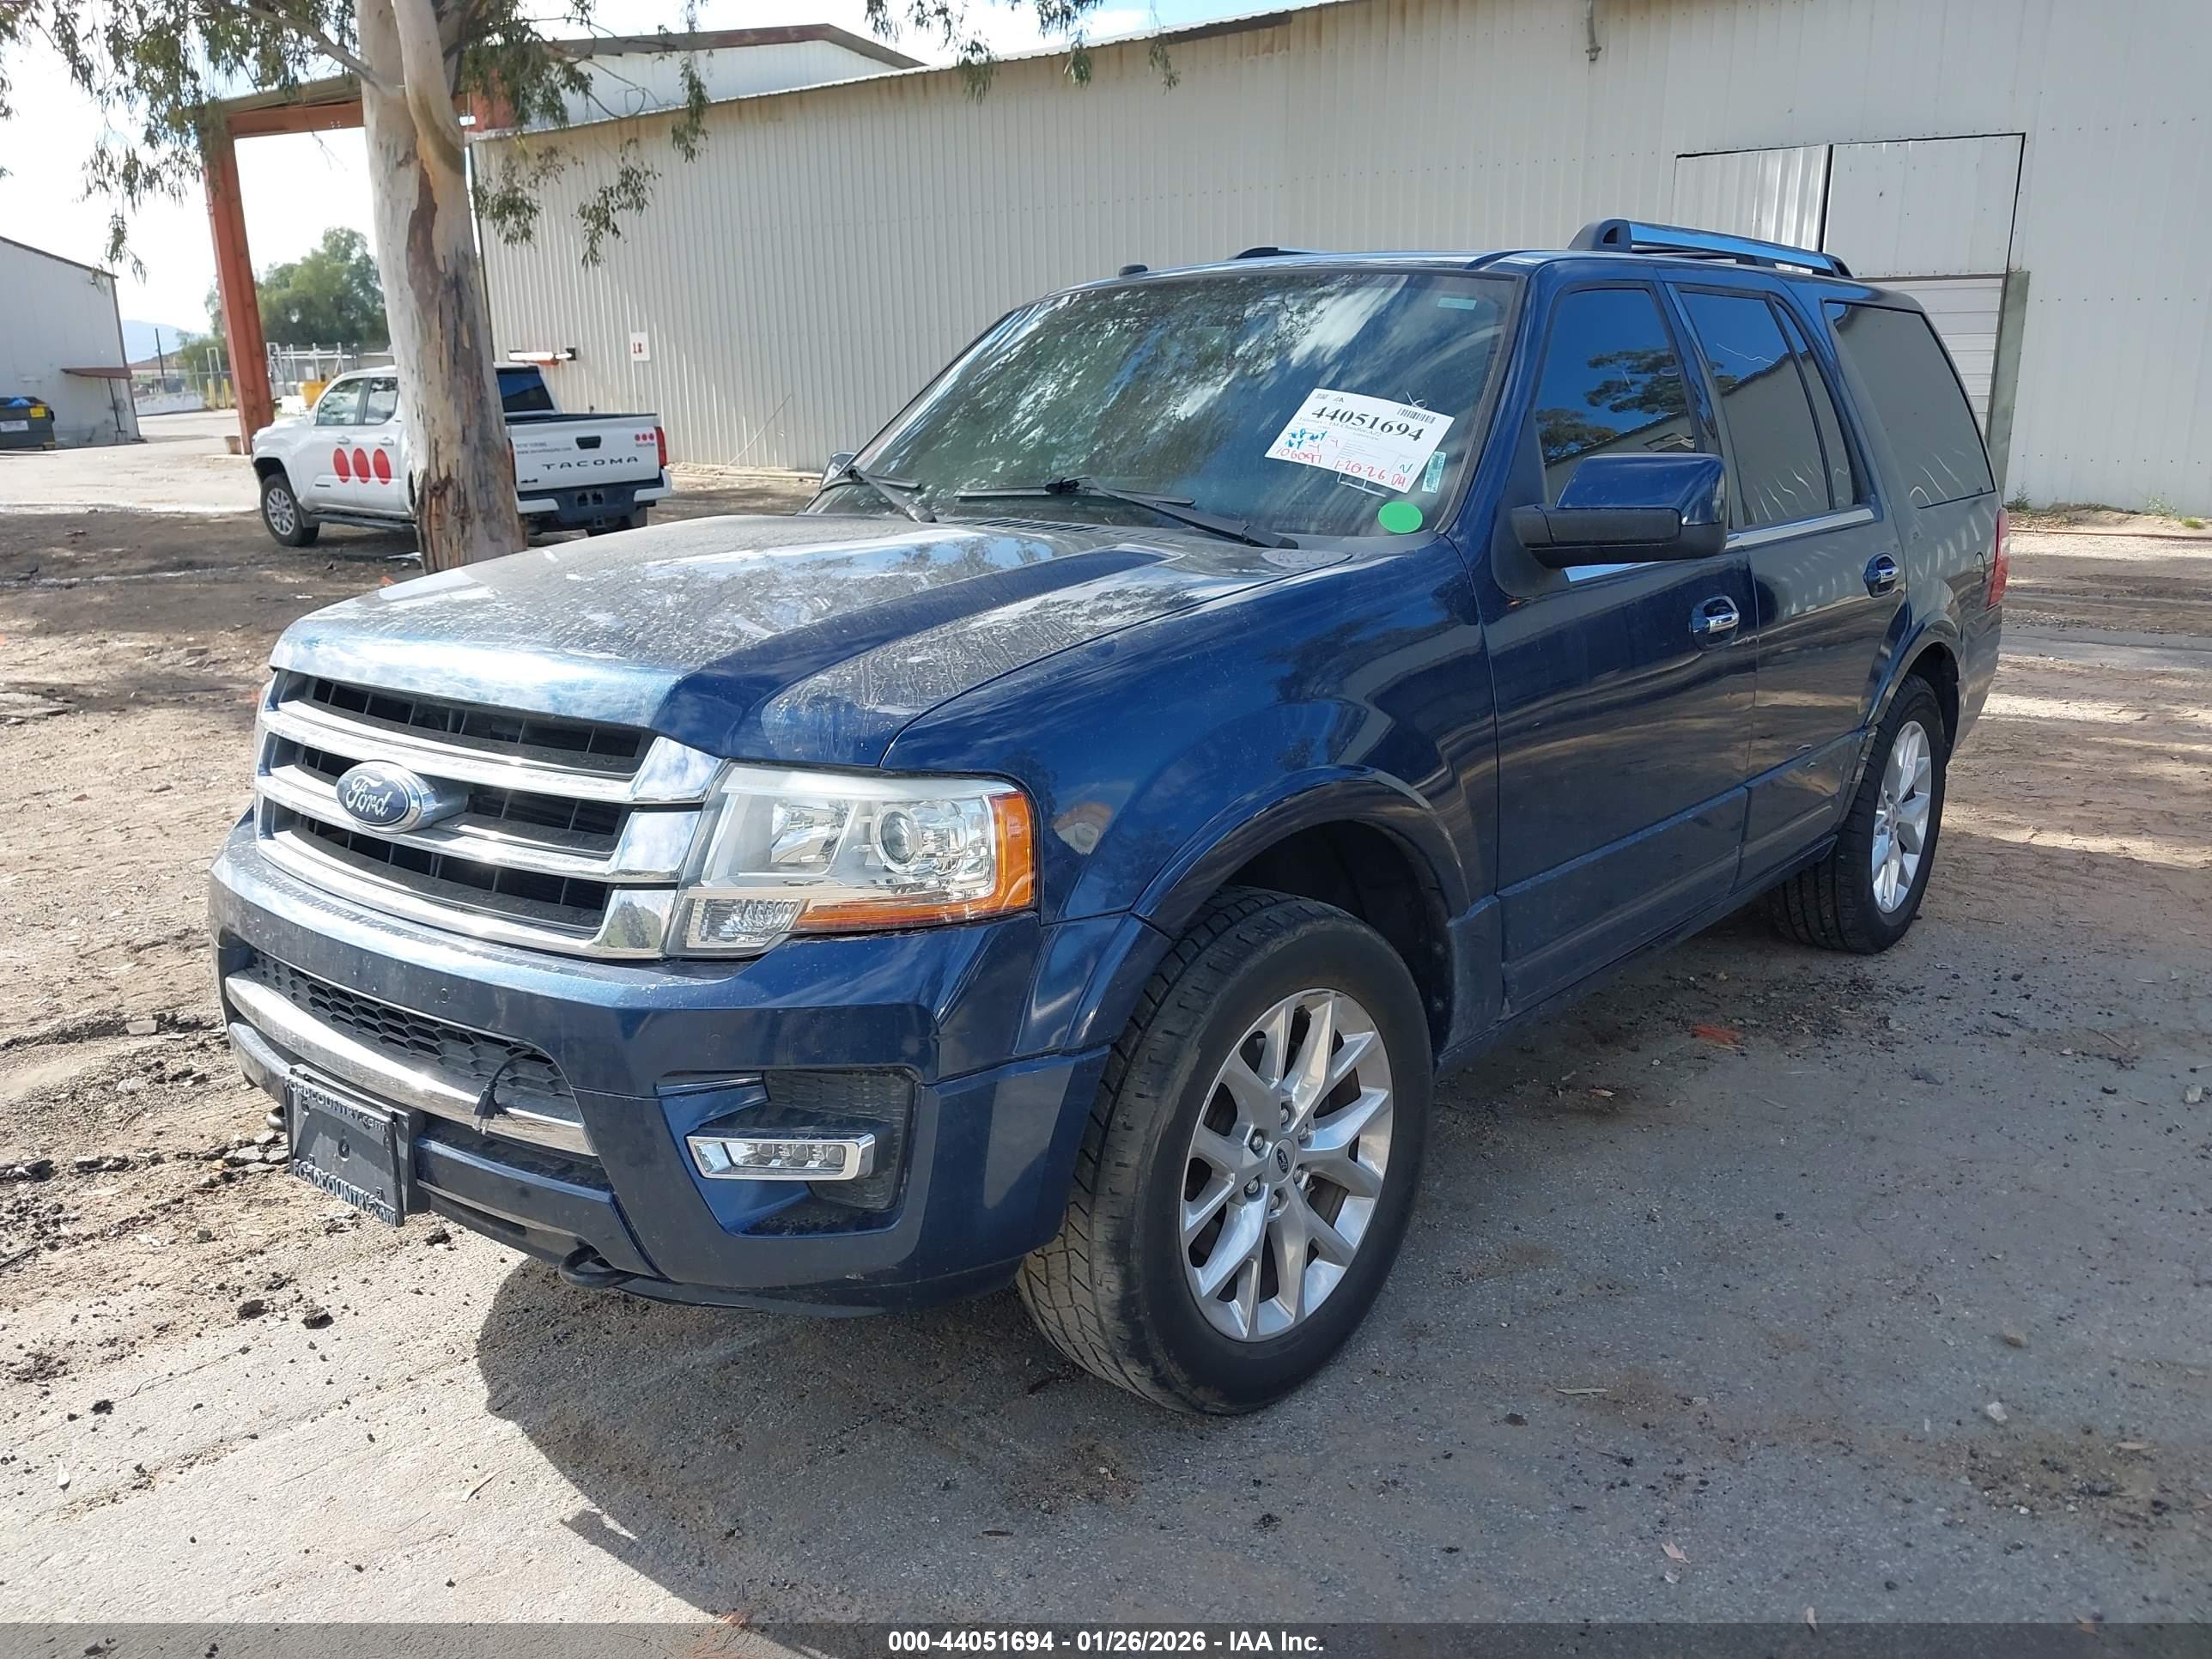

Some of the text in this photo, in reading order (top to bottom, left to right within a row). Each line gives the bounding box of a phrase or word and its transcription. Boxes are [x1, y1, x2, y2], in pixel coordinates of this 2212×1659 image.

[1311, 405, 1425, 441] 44051694
[542, 456, 639, 471] TACOMA
[345, 775, 393, 817] Ford
